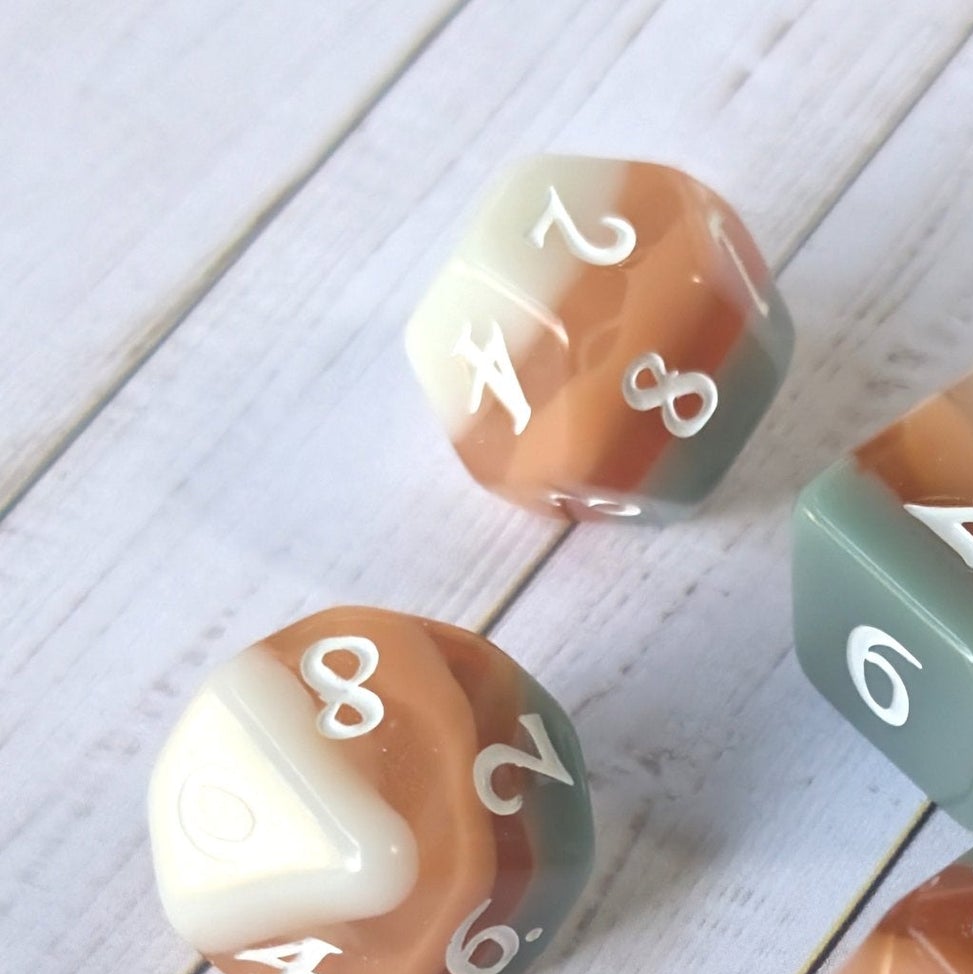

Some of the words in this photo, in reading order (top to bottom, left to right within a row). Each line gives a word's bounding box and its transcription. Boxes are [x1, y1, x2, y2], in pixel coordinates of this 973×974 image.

[526, 186, 637, 266] 2
[451, 319, 533, 437] 4
[622, 352, 719, 439] 8
[300, 635, 385, 740] 8
[845, 623, 924, 728] 6
[473, 712, 575, 816] 2
